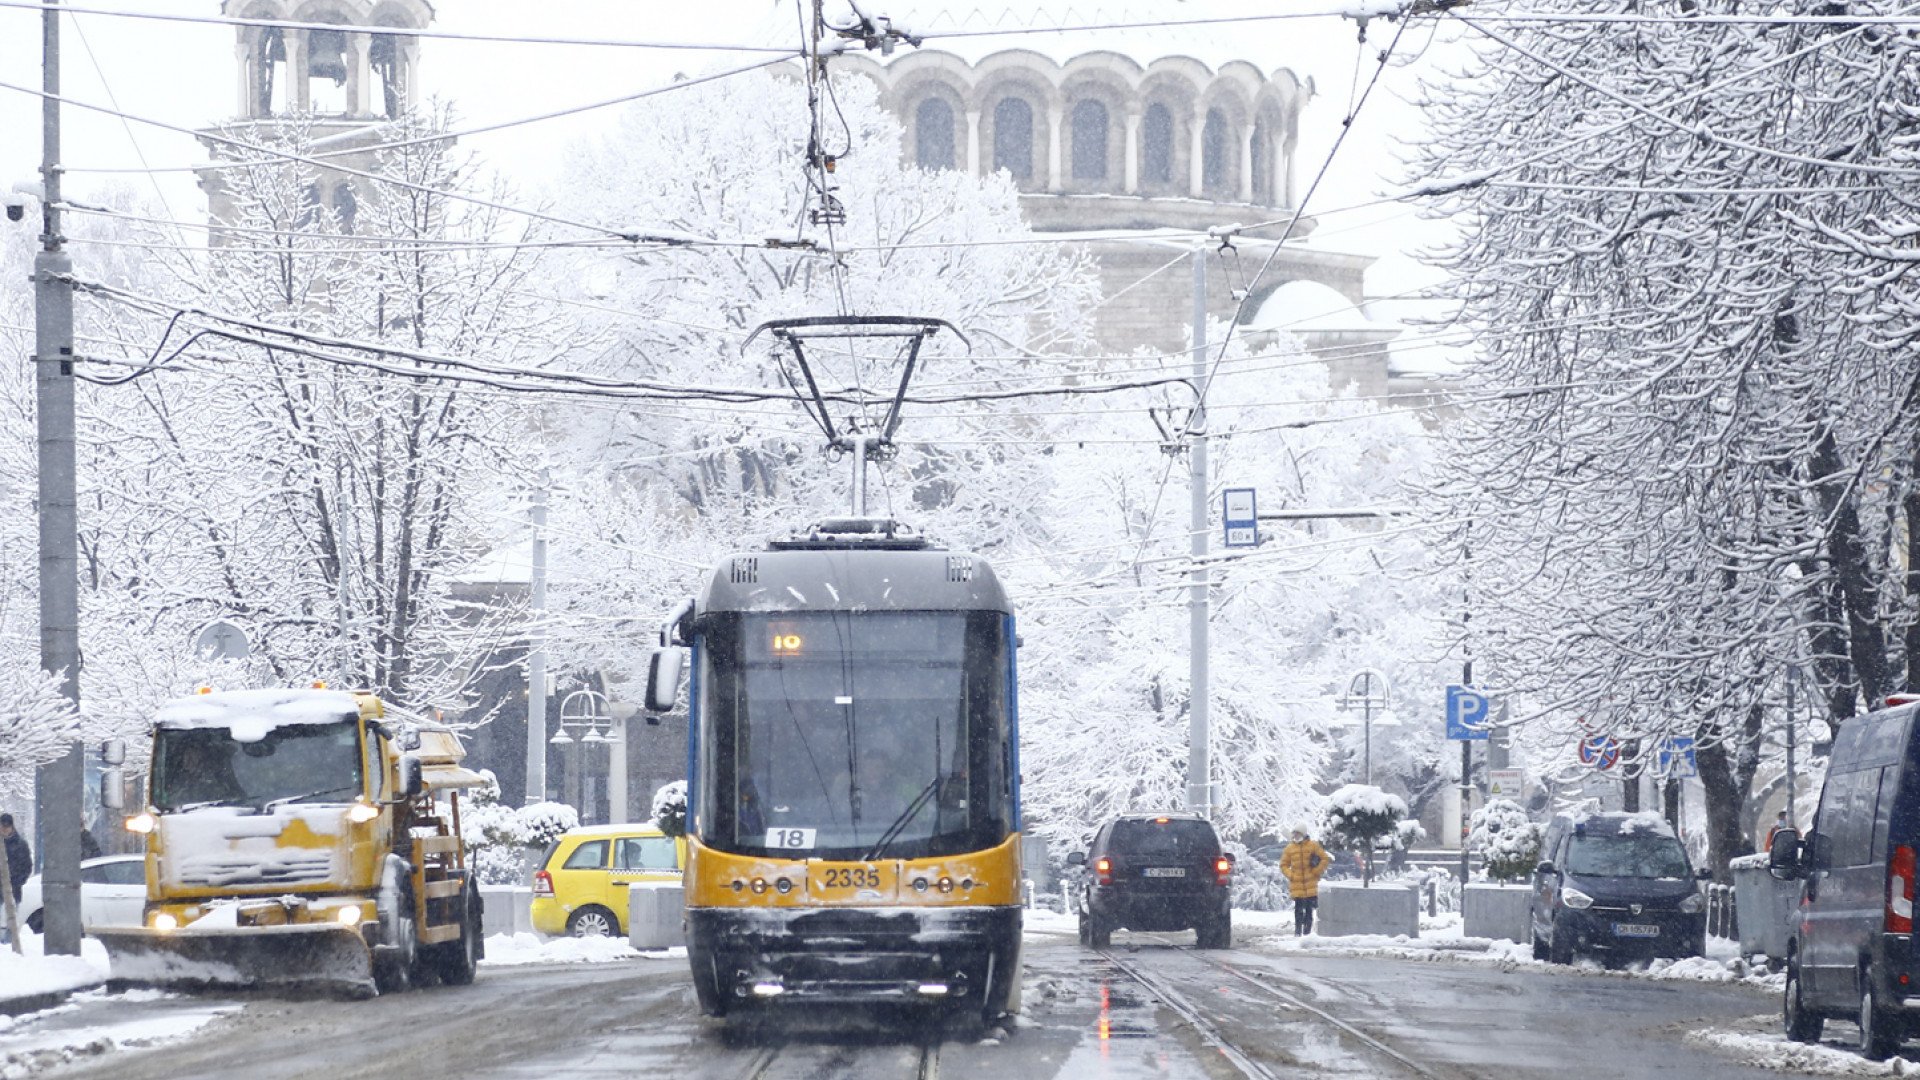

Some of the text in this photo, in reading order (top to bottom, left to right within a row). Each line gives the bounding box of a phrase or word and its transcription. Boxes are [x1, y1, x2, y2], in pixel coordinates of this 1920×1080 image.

[1458, 695, 1480, 724] P
[777, 830, 804, 847] 18
[825, 868, 881, 888] 2335
